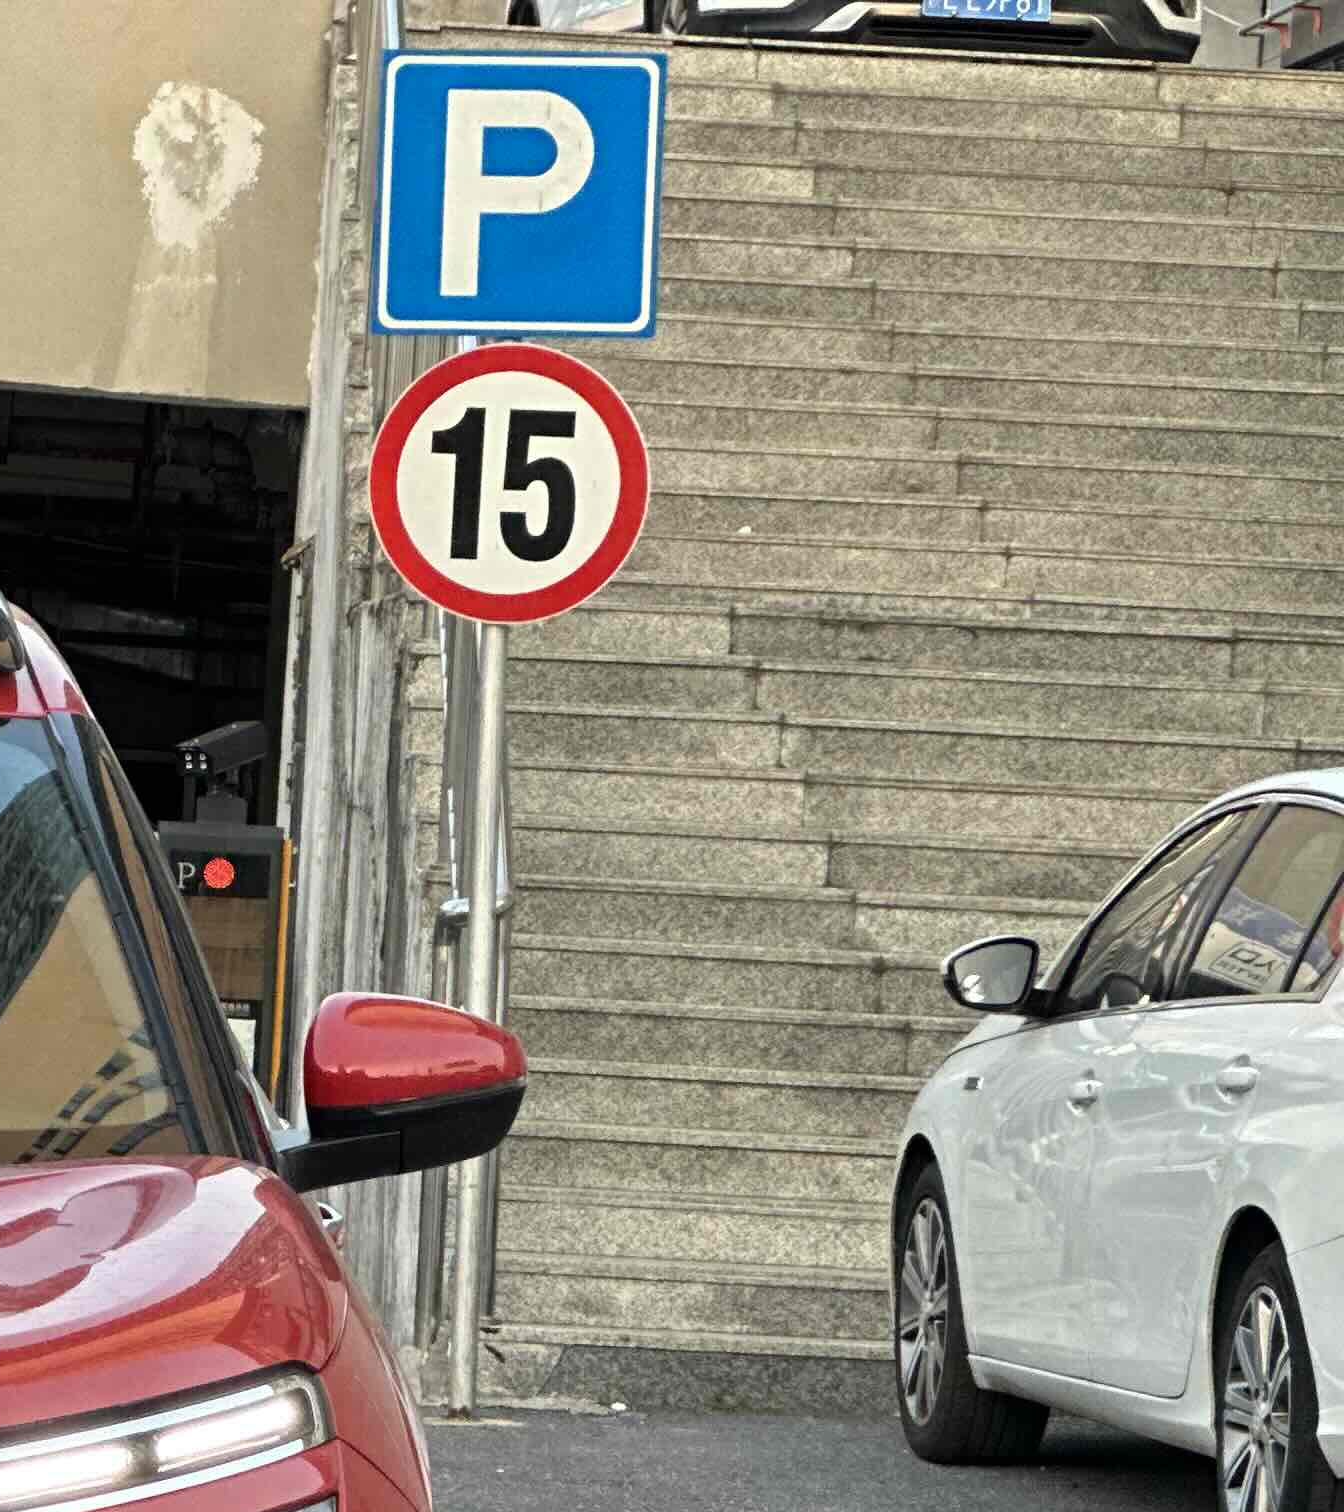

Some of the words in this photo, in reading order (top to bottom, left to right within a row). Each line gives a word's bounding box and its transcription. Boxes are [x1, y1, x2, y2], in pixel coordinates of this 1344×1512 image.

[440, 88, 594, 297] P
[430, 407, 577, 563] 15
[176, 861, 196, 889] P
